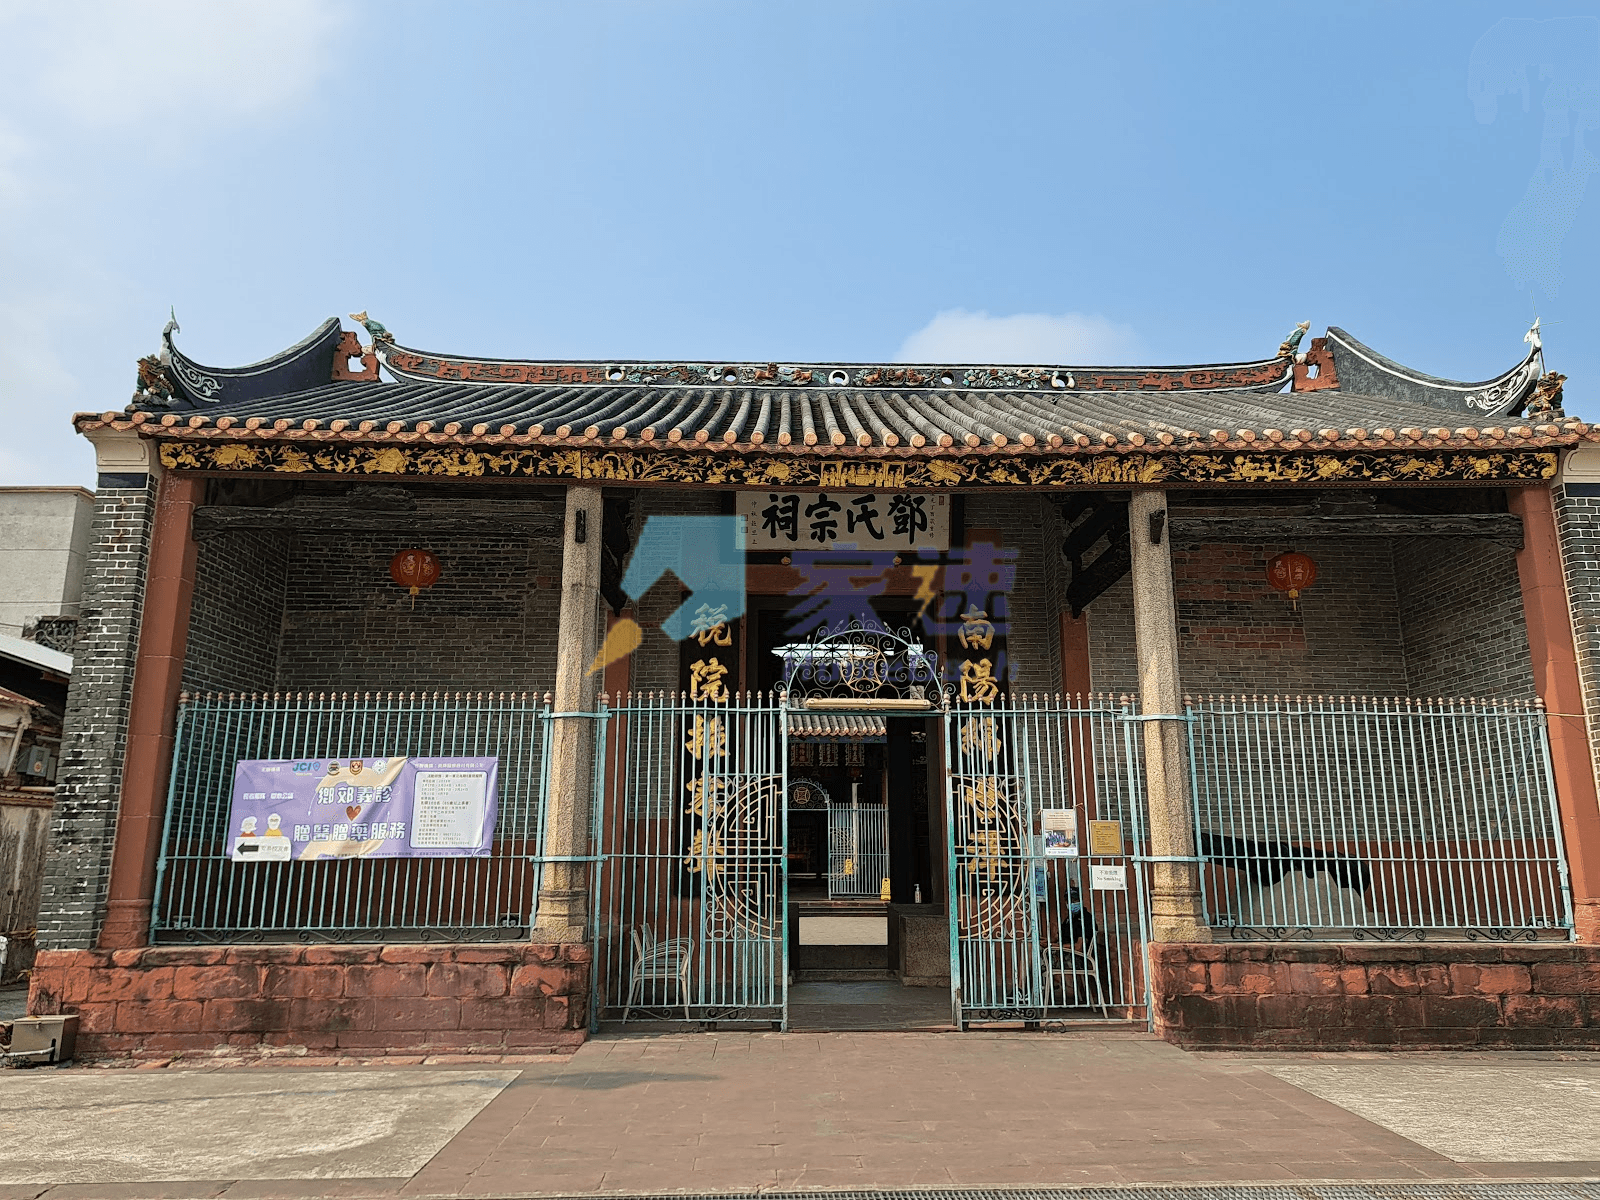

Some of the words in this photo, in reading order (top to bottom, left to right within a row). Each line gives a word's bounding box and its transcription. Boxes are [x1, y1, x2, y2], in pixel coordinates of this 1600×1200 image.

[761, 492, 928, 545] 鄧氏宗祠
[292, 762, 312, 772] JCI
[317, 785, 393, 805] 鄉郊義診
[293, 822, 406, 842] 贈醫贈藥服務
